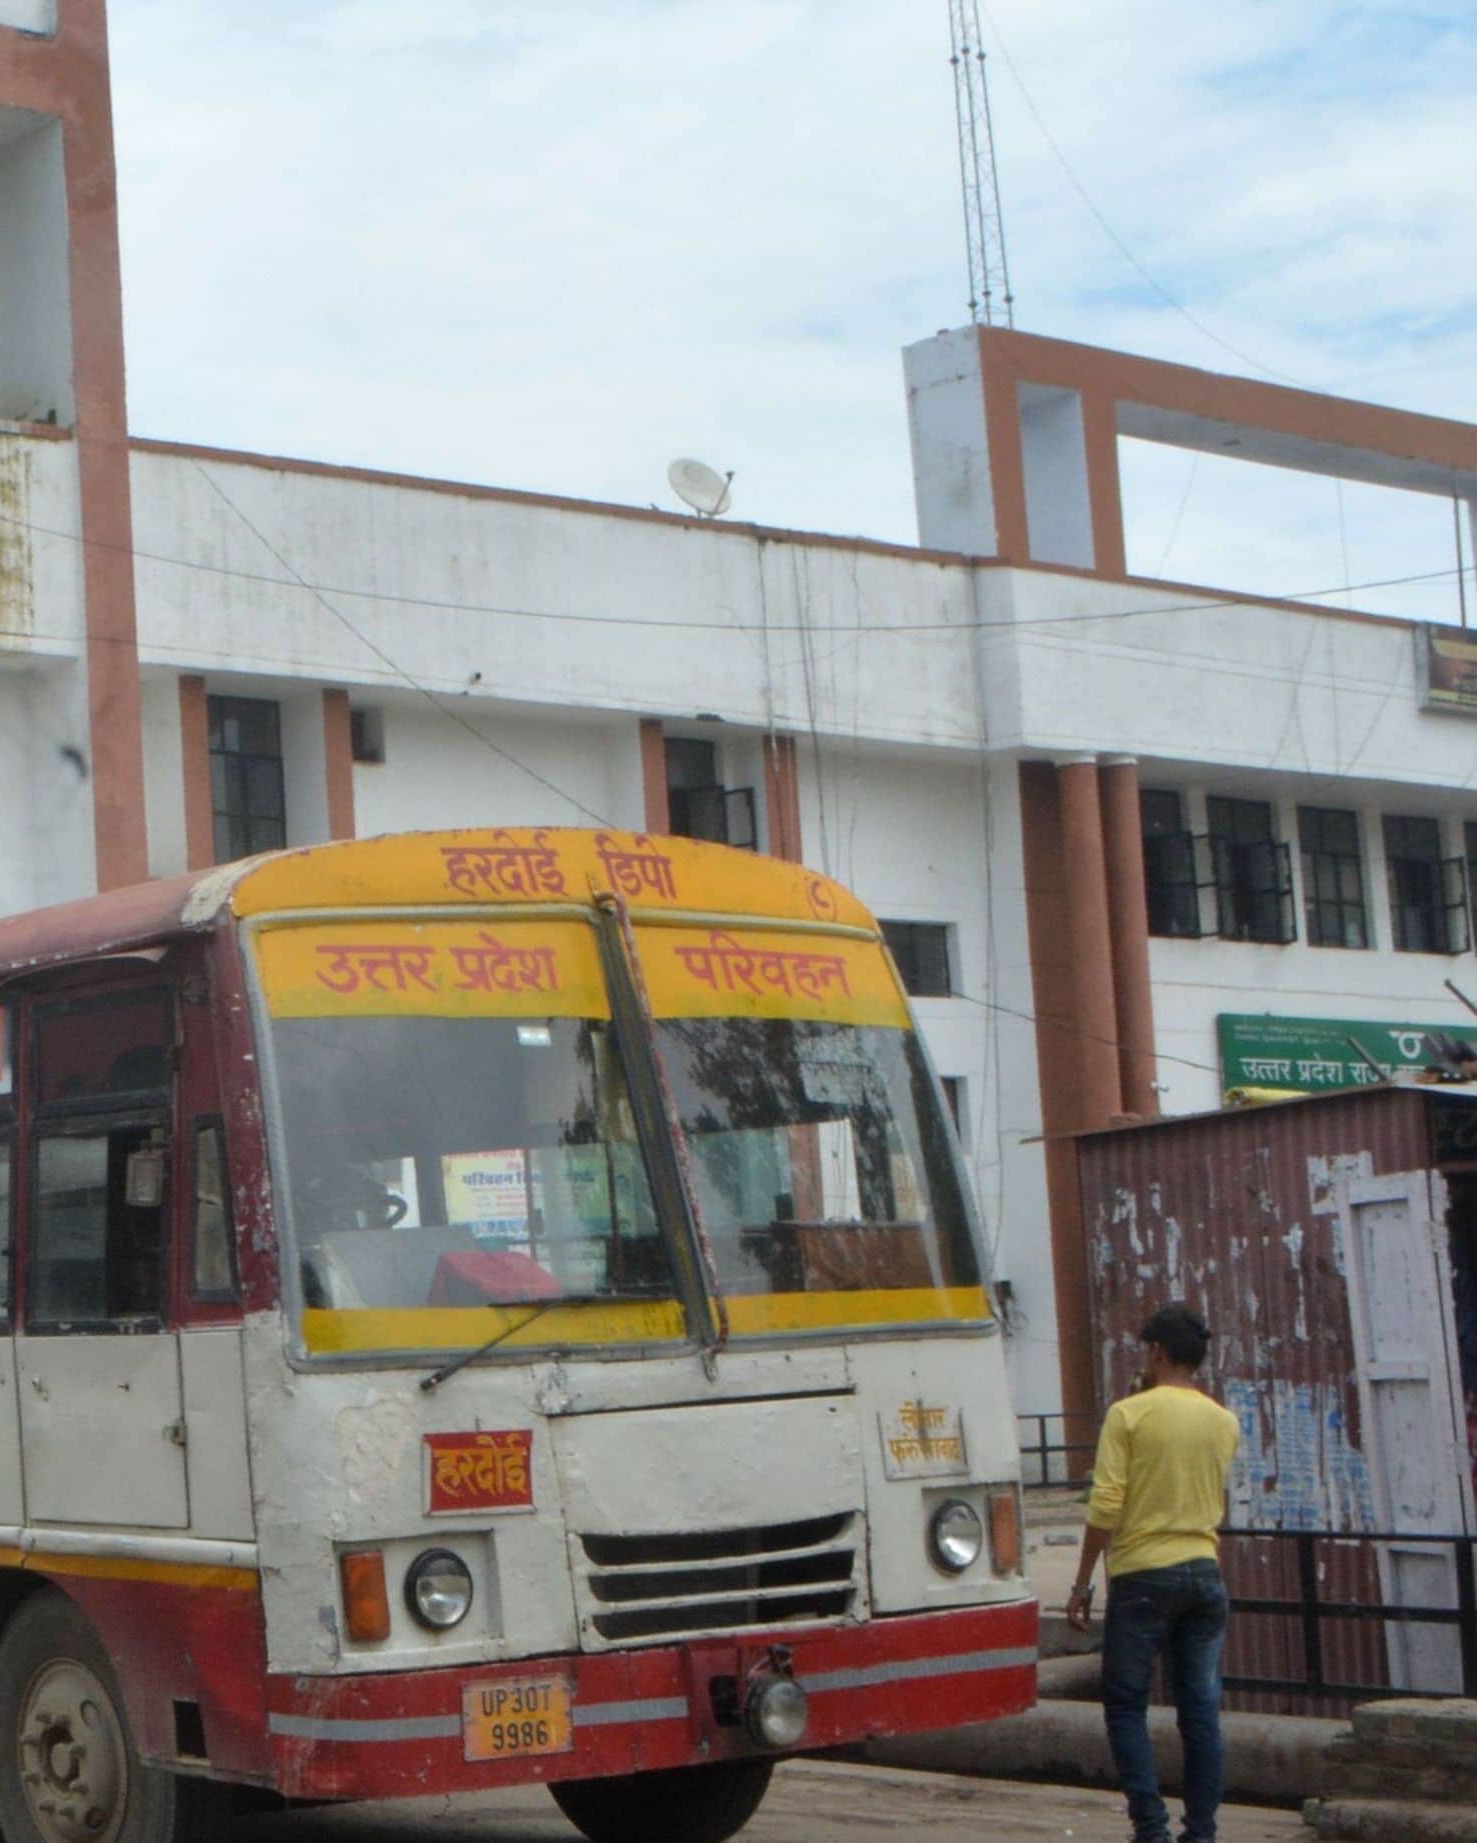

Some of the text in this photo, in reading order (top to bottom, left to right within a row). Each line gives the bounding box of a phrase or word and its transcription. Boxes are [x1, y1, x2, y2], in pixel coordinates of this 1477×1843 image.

[440, 830, 677, 899] हरदोई डिपो
[315, 931, 560, 993] उत्तर प्रदेश
[674, 929, 852, 1000] परिवहन
[1239, 1057, 1291, 1082] उत्तर
[1296, 1051, 1344, 1084] प्रदेश
[433, 1433, 528, 1498] हरदोई
[481, 1684, 552, 1717] UP30T
[492, 1720, 549, 1750] 9986
